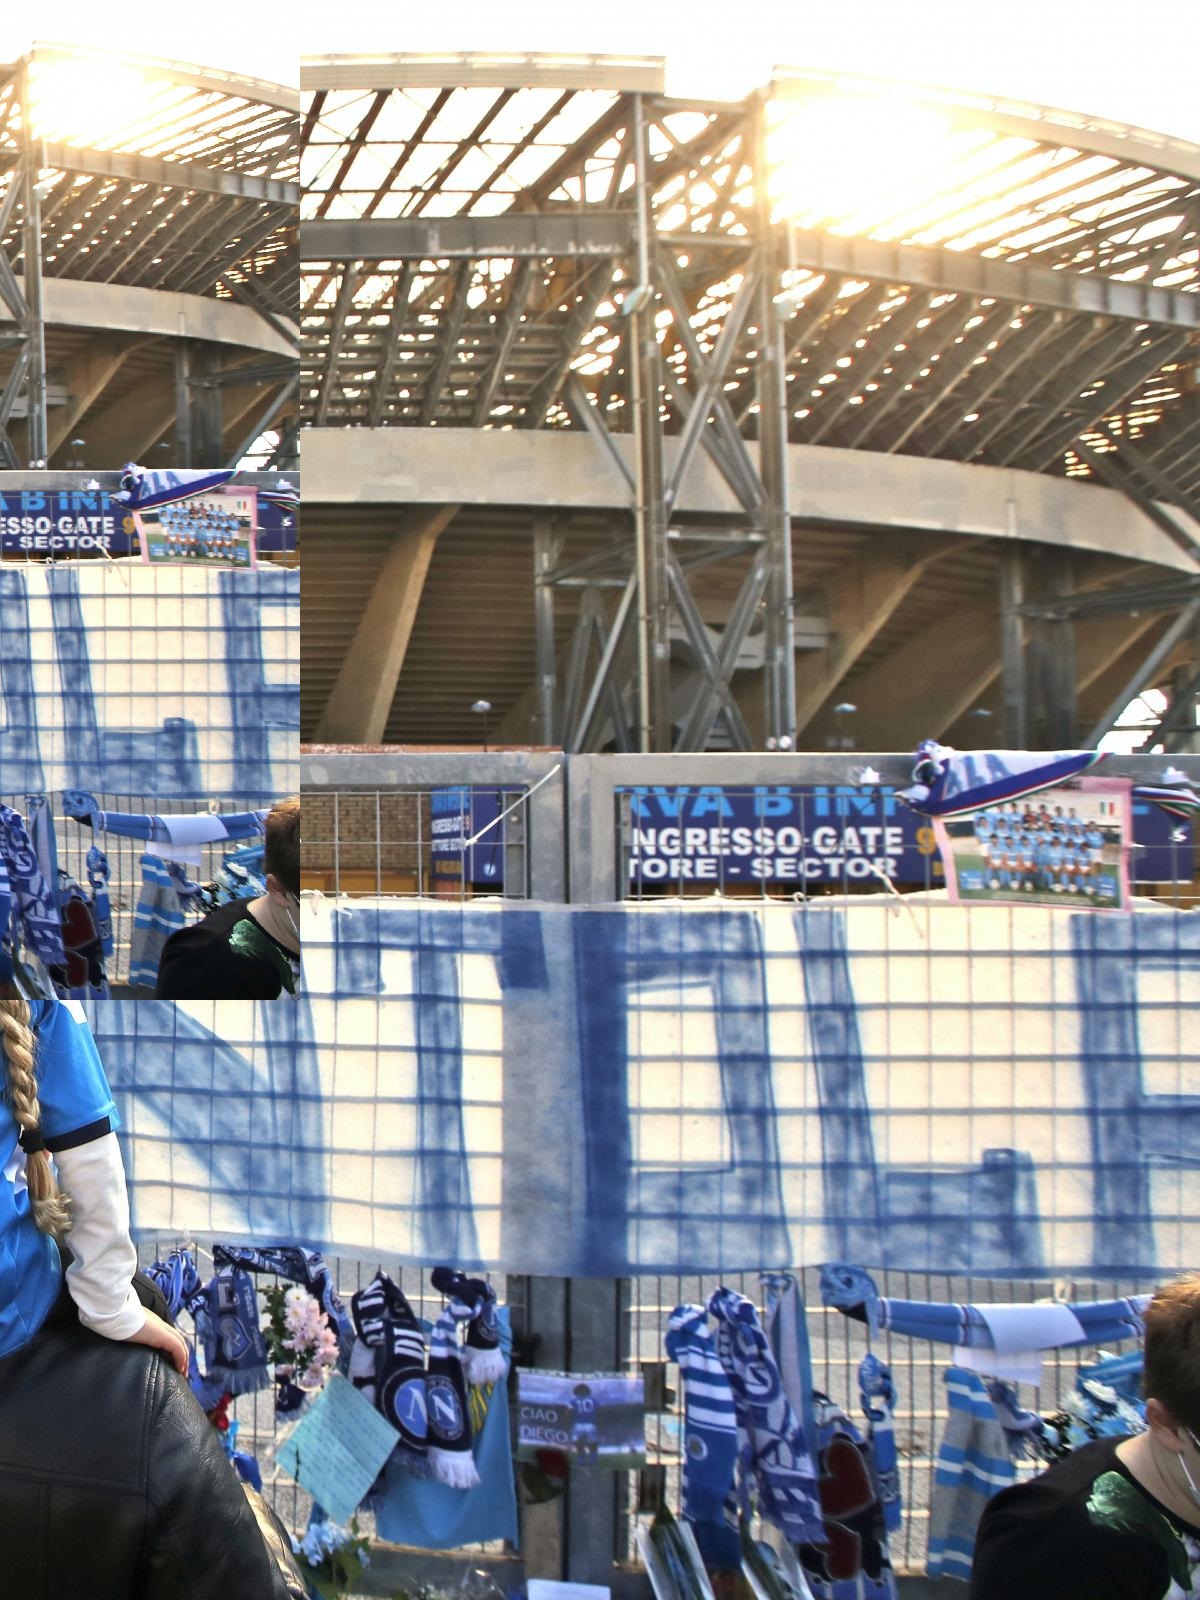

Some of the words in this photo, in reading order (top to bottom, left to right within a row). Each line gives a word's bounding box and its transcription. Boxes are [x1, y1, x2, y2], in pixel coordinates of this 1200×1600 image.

[122, 517, 135, 535] 9
[19, 536, 111, 549] SECTOR
[916, 827, 936, 856] 9
[752, 857, 898, 879] SECTOR
[520, 1407, 558, 1423] CIAO
[520, 1425, 569, 1443] DIEGO
